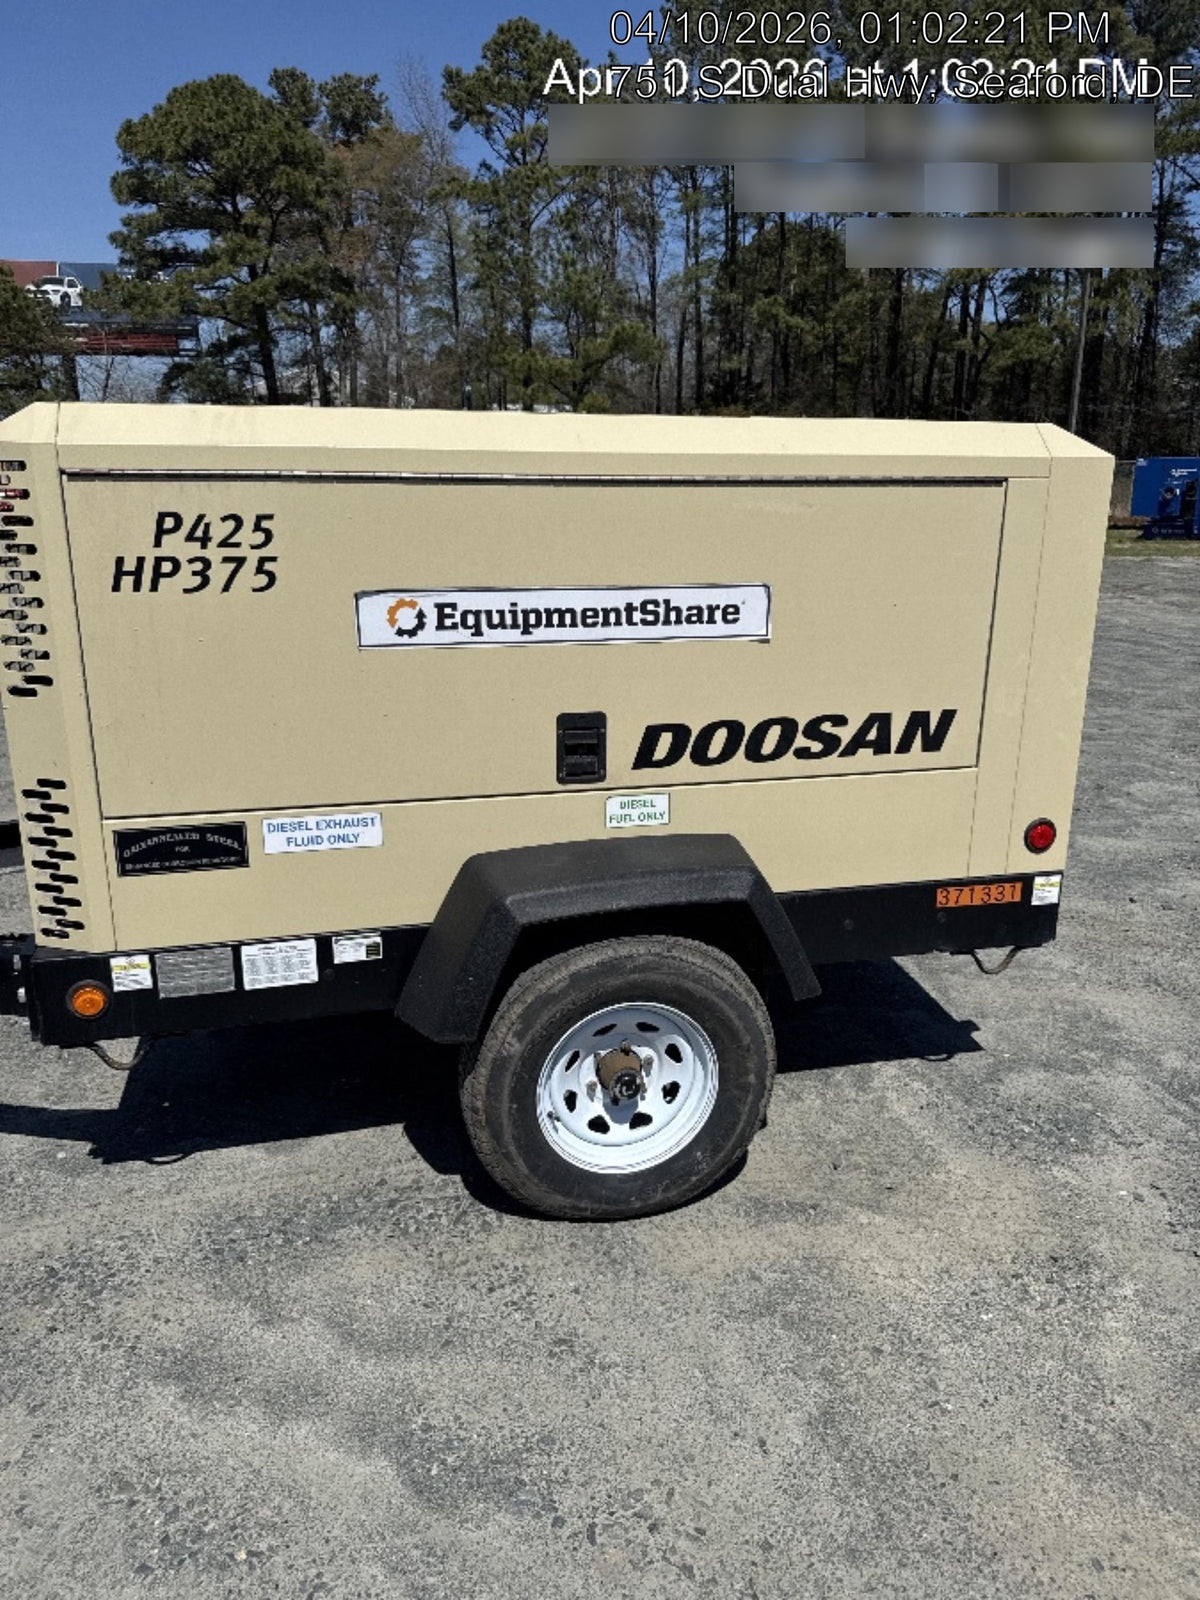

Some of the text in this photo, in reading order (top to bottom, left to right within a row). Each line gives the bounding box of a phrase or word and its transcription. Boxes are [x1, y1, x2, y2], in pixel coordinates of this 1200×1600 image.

[153, 511, 275, 550] P425
[111, 556, 279, 594] HP375
[434, 598, 742, 637] EquipmentShare
[631, 709, 958, 770] DOOSAN
[620, 799, 656, 809] DIESEL
[266, 815, 378, 834] DIESEL EXHAUST
[608, 811, 666, 824] FUEL ONLY
[285, 832, 361, 848] FLUID ONLY
[938, 884, 1017, 906] 371331
